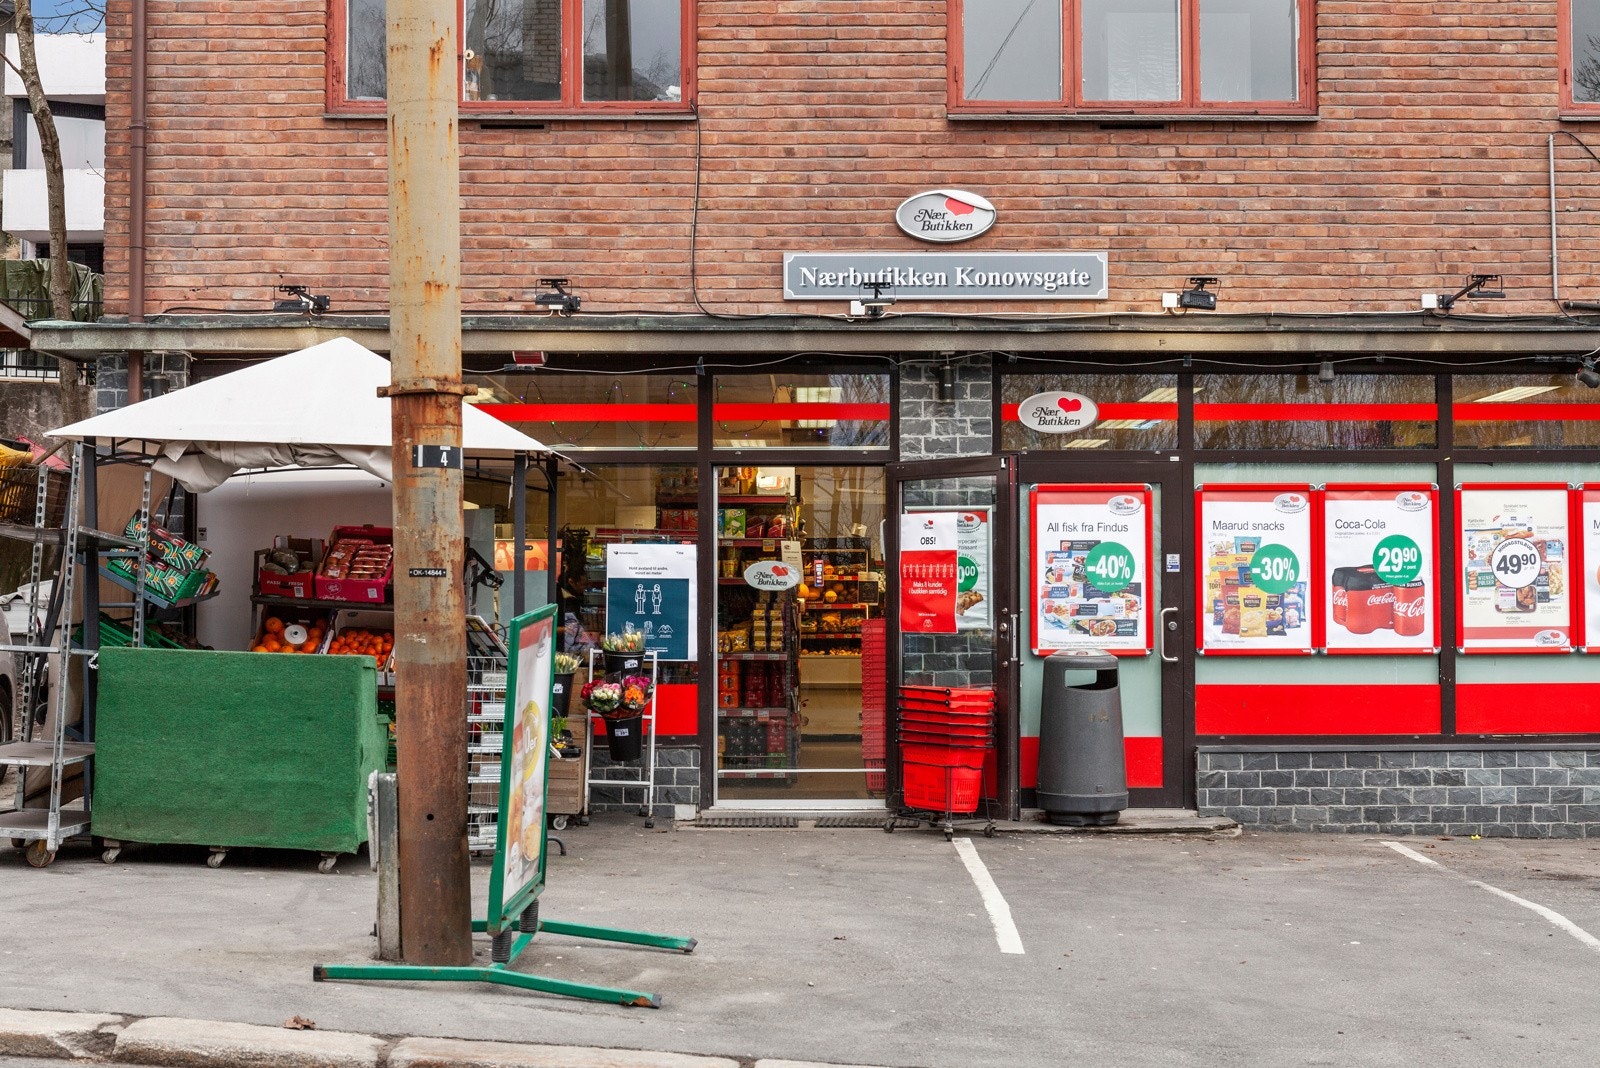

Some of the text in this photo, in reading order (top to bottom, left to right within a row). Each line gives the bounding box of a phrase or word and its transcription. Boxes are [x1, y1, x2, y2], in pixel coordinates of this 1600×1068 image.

[914, 209, 948, 222] Nær
[921, 220, 973, 231] Butikken
[799, 267, 1090, 291] Nærbutikken Konowsgate
[1032, 407, 1060, 418] Nær
[1038, 416, 1081, 426] Butikken
[440, 451, 449, 467] 4
[1047, 522, 1129, 532] All fisk fra Findus
[1213, 520, 1285, 530] Maarud snacks
[1335, 519, 1386, 529] Coca-Cola
[920, 537, 936, 545] OBS!
[1087, 555, 1131, 579] -40%
[1251, 557, 1295, 581] -30%
[754, 571, 773, 579] Nær
[757, 579, 788, 587] Butikken
